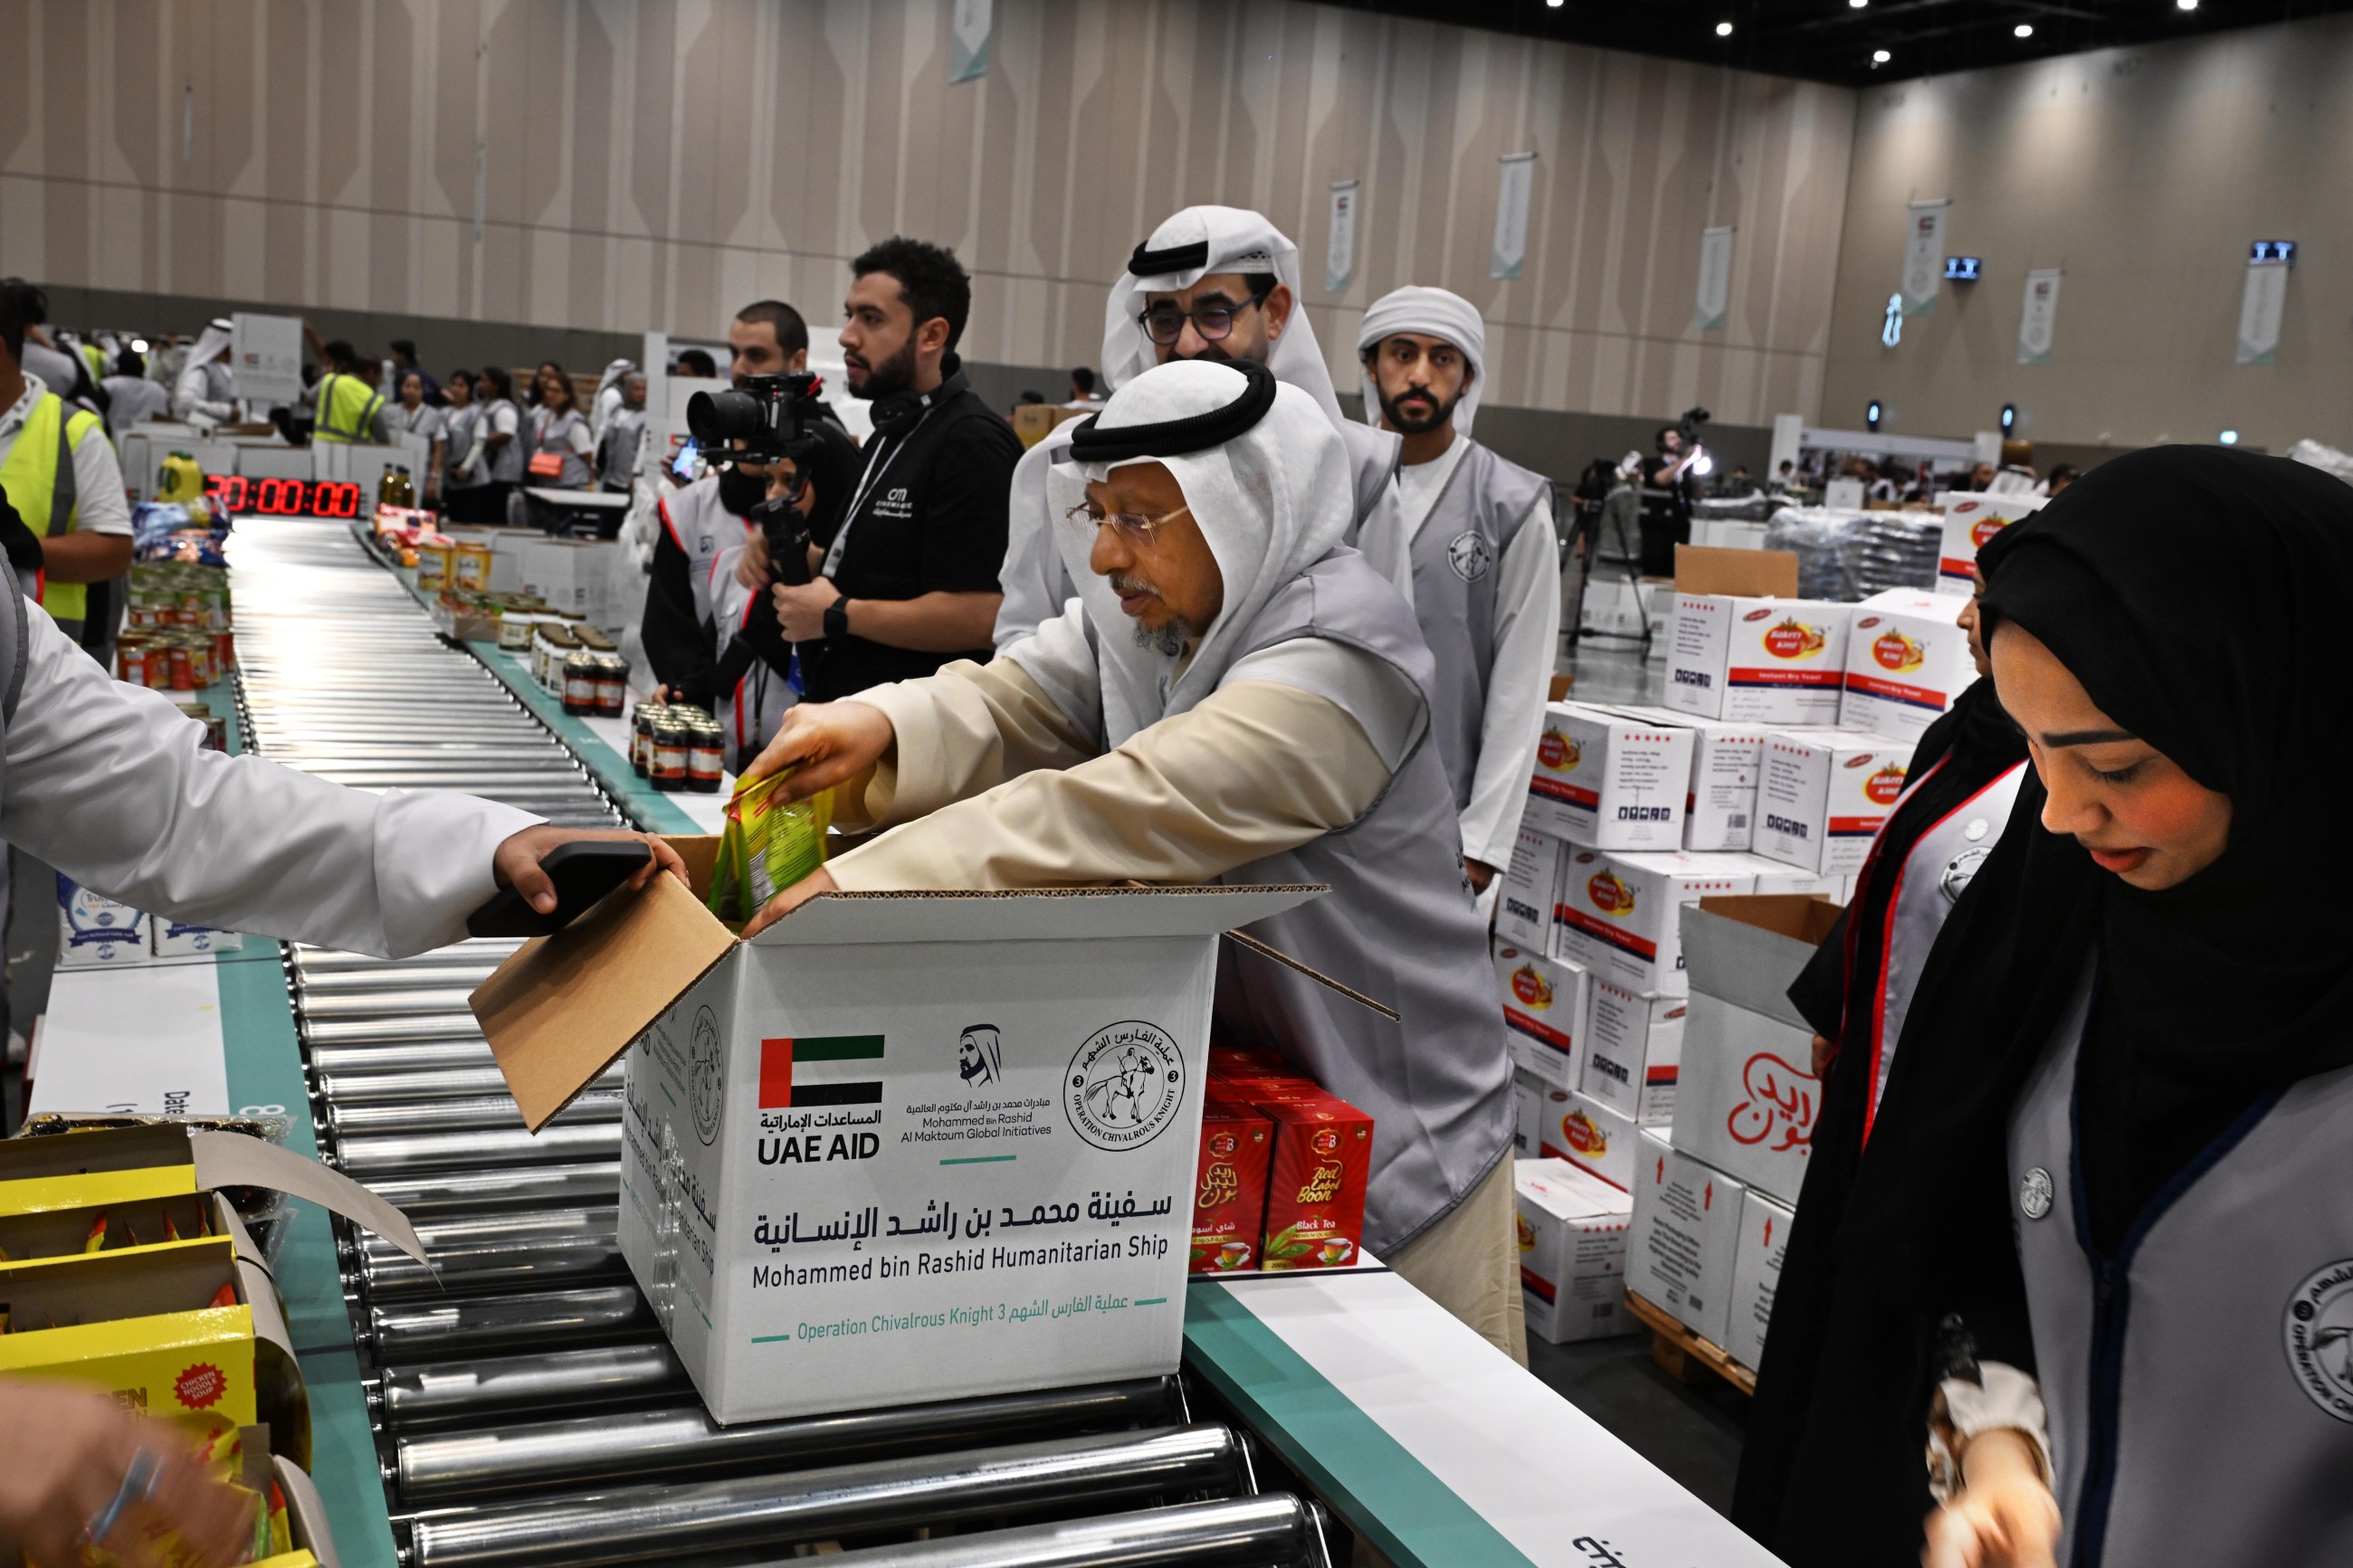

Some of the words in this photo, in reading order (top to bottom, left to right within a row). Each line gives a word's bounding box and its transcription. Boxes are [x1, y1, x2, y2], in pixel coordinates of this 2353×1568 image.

[1115, 1029, 1157, 1044] الفارس
[1082, 1035, 1110, 1071] الشهم
[1154, 1038, 1174, 1066] عملية
[906, 1104, 937, 1115] العالمية
[938, 1103, 962, 1114] مكتوم
[964, 1100, 972, 1112] آل
[973, 1100, 991, 1112] راشد
[993, 1102, 1001, 1111] بن
[1003, 1100, 1022, 1108] محمد
[1024, 1098, 1051, 1108] مبادرات
[760, 1113, 812, 1134] الإماراتية
[814, 1110, 881, 1127] المساعدات
[923, 1115, 985, 1128] Mohammed
[998, 1112, 1033, 1124] Rashid
[1073, 1094, 1101, 1136] OPERATION
[1102, 1120, 1156, 1142] CHIVALROUS
[1154, 1089, 1176, 1124] KNIGHT
[900, 1132, 912, 1143] Al
[915, 1131, 964, 1142] Maktoum
[967, 1126, 1000, 1140] Global
[1003, 1126, 1052, 1137] Initiatives
[757, 1136, 822, 1164] UAE
[826, 1132, 880, 1161] AID
[1313, 1164, 1340, 1180] Red
[1297, 1186, 1332, 1203] Boon
[1000, 1202, 1079, 1227] محمد
[1088, 1191, 1171, 1227] سفينة
[887, 1200, 957, 1240] راشد
[966, 1208, 991, 1238] بن
[1297, 1220, 1319, 1231] Black
[1322, 1219, 1336, 1229] Tea
[754, 1207, 878, 1253] الإنسانية
[753, 1258, 872, 1288] Mohammed
[881, 1255, 910, 1278] bin
[919, 1249, 985, 1275] Rashid
[992, 1239, 1121, 1269] Humanitarian
[1129, 1234, 1168, 1259] Ship
[1009, 1299, 1048, 1323] الشهم
[1052, 1295, 1091, 1319] الفارس
[1095, 1294, 1128, 1314] عملية
[797, 1318, 867, 1343] Operation
[872, 1311, 945, 1332] Chivalrous
[950, 1307, 993, 1326] Knight
[998, 1304, 1005, 1320] 3
[180, 1371, 215, 1390] CHICKEN
[184, 1377, 217, 1396] NOODLE
[192, 1386, 214, 1400] SOUP
